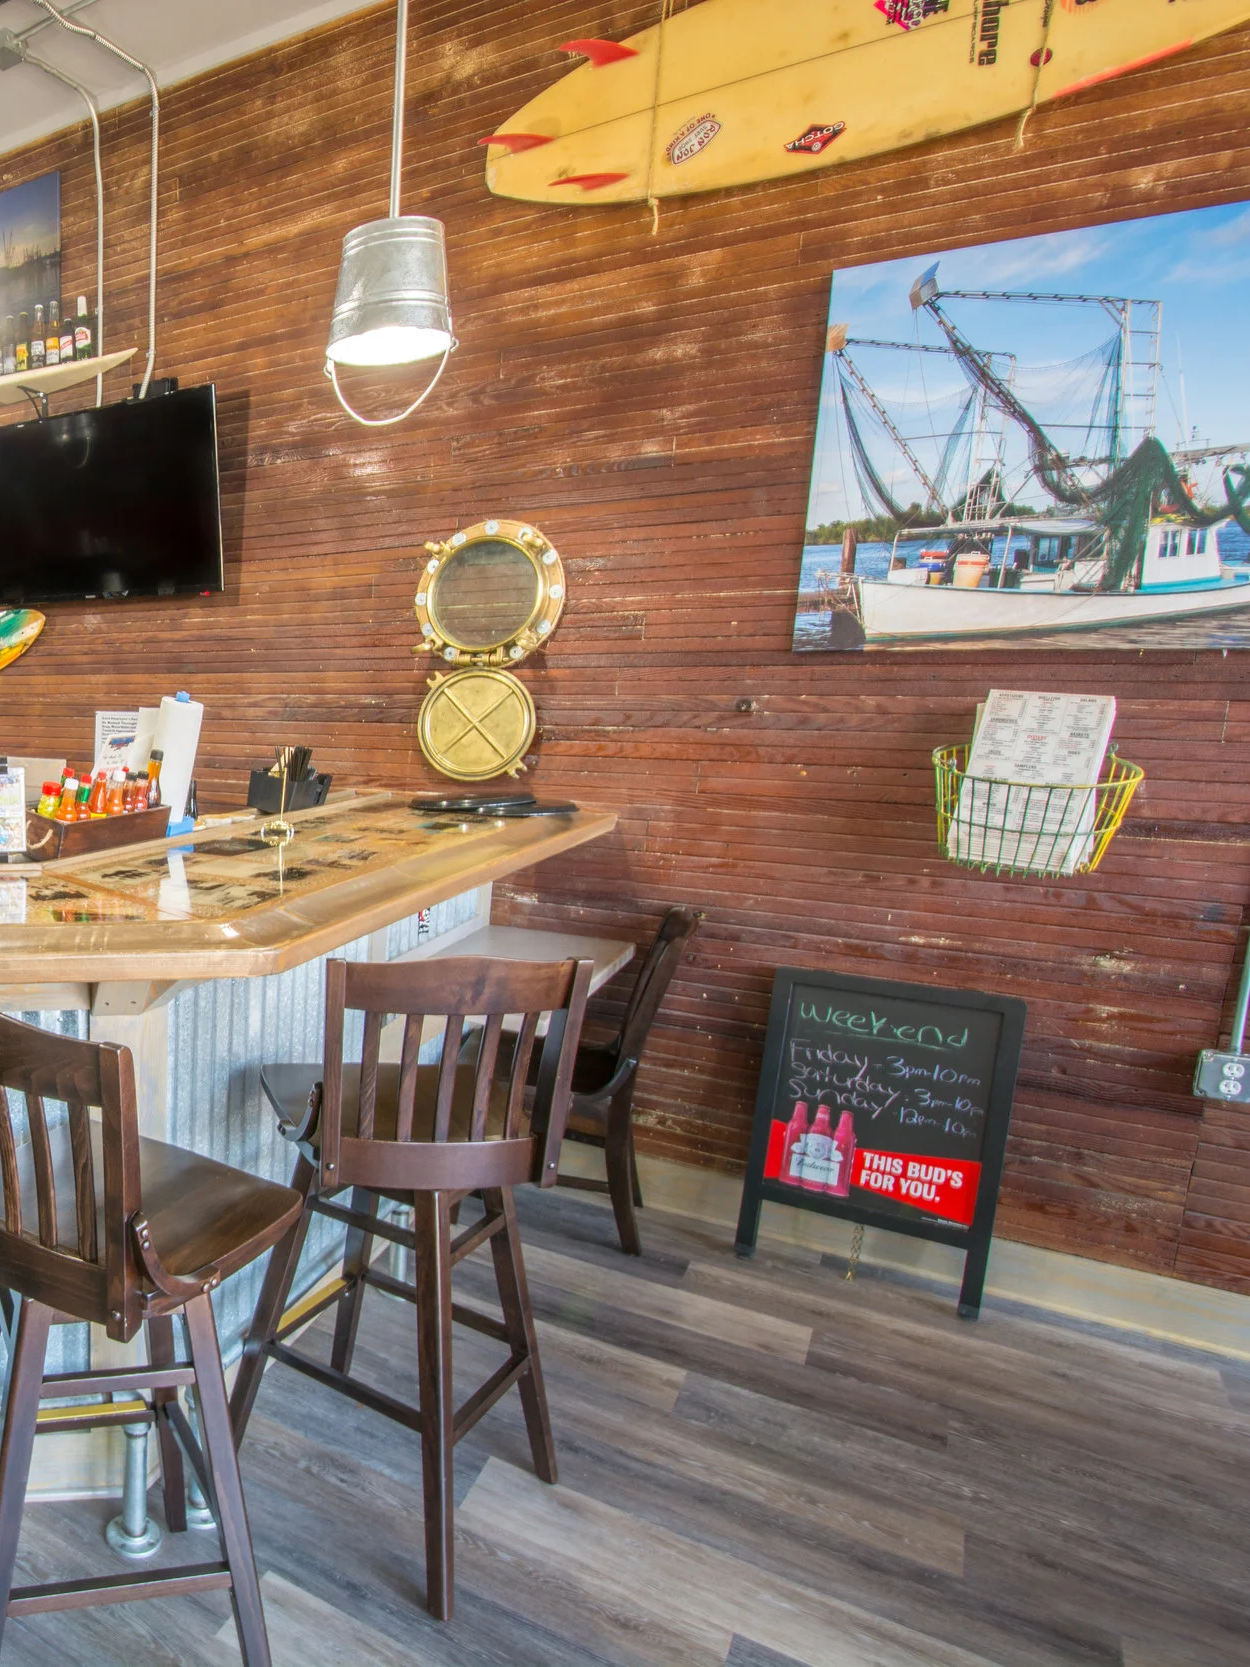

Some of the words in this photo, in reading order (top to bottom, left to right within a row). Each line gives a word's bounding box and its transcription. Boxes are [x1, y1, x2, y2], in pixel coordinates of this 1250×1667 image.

[786, 121, 845, 150] GOTCHA
[790, 1037, 868, 1080] Friday
[788, 1078, 884, 1120] Sunday
[791, 1061, 901, 1109] Saturday
[859, 1168, 895, 1193] FOR
[900, 1177, 941, 1203] YOU.
[863, 1151, 904, 1175] THIS
[907, 1161, 964, 1189] BUD'S
